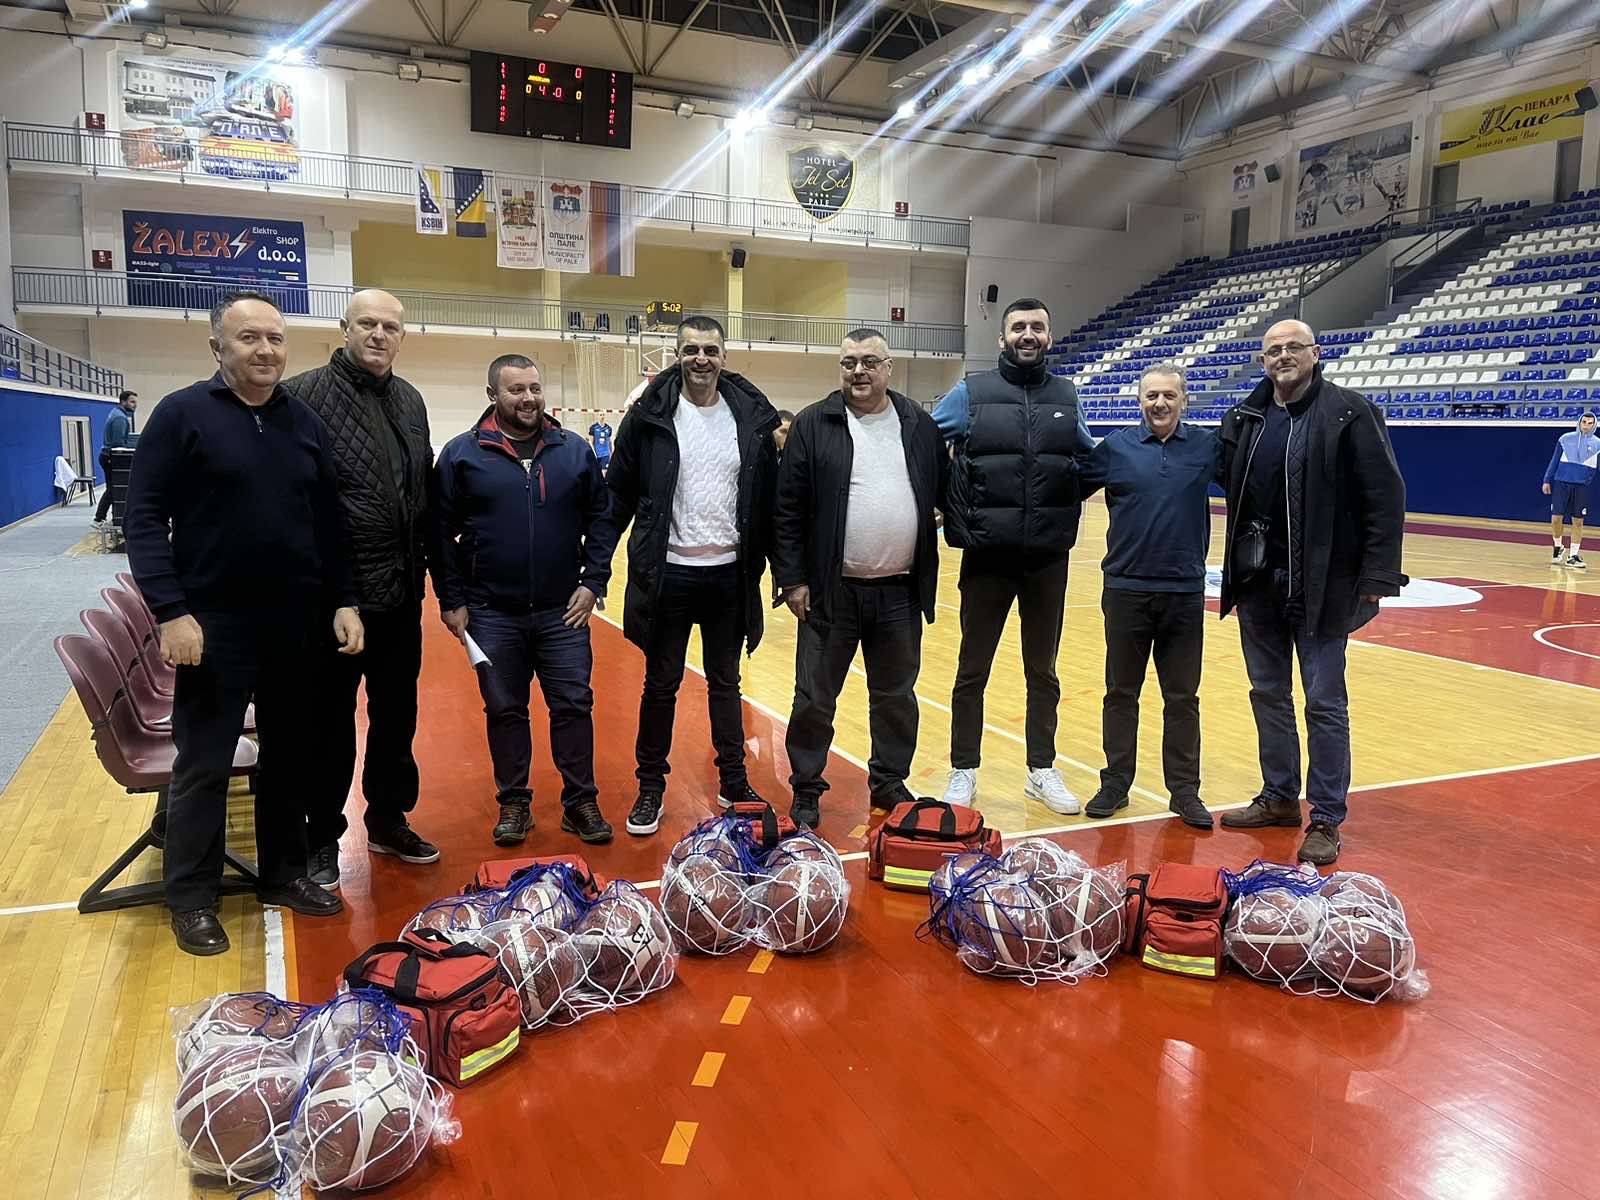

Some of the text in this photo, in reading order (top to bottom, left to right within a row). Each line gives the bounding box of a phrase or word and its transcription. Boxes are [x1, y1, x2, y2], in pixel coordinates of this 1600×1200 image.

[806, 156, 836, 167] HOTEL
[252, 226, 278, 235] Elektro
[132, 221, 231, 258] ŽALEX
[276, 236, 299, 246] SHOP
[549, 231, 585, 241] ОПШТИНА
[557, 240, 577, 248] ПАЛЕ
[258, 245, 302, 263] d.o.o.
